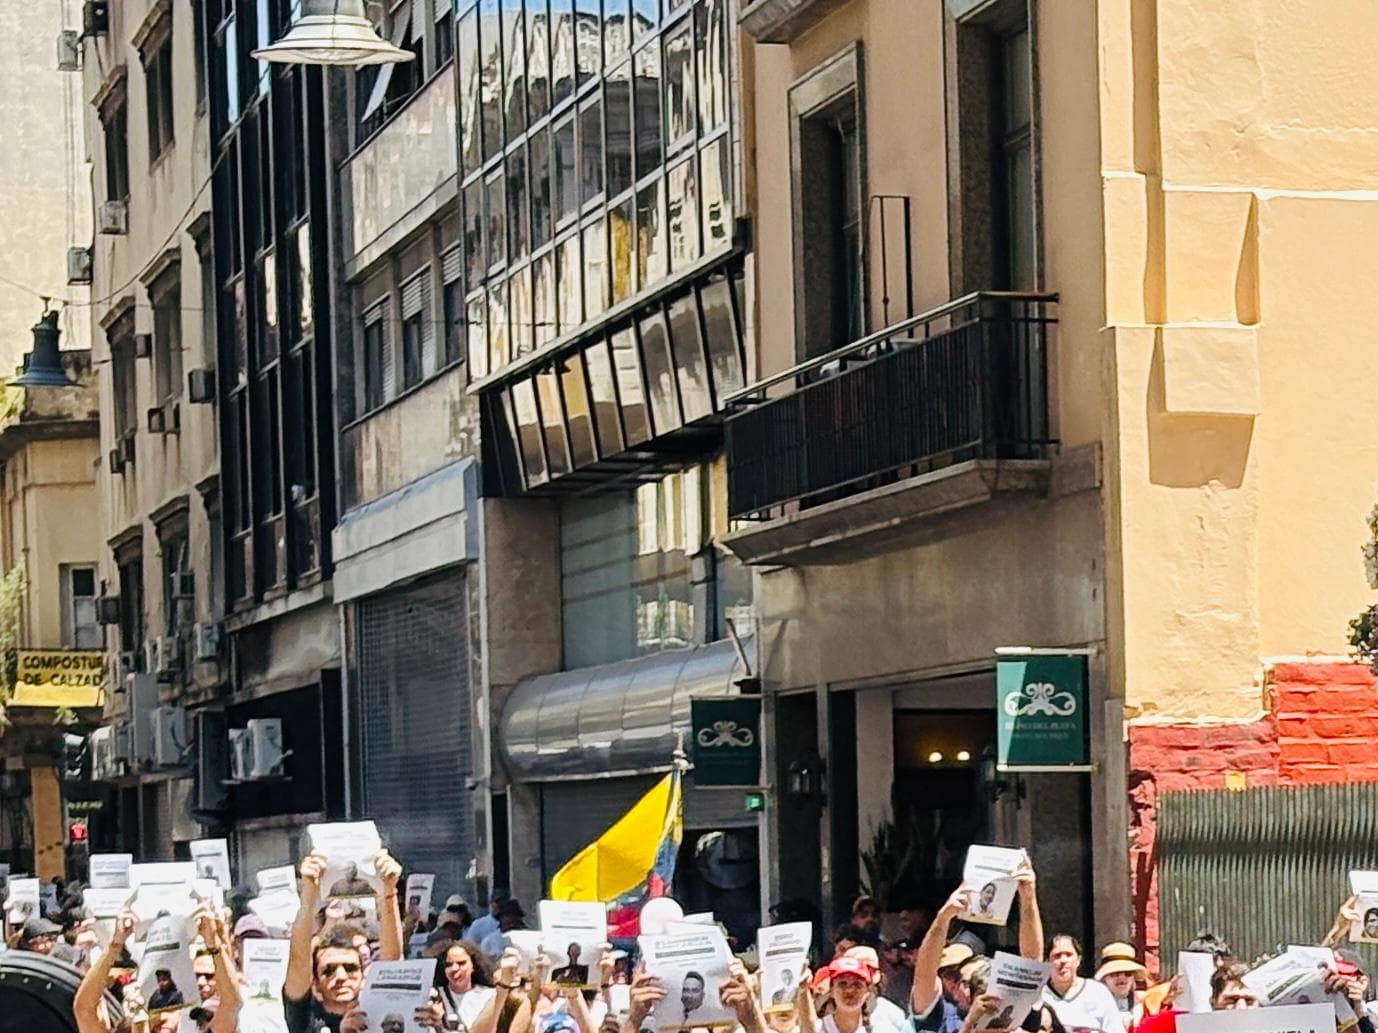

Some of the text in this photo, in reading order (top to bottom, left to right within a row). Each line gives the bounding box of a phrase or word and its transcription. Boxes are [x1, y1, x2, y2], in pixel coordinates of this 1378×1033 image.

[23, 656, 103, 670] COMPOSTUR
[24, 673, 103, 687] DE CALZAD
